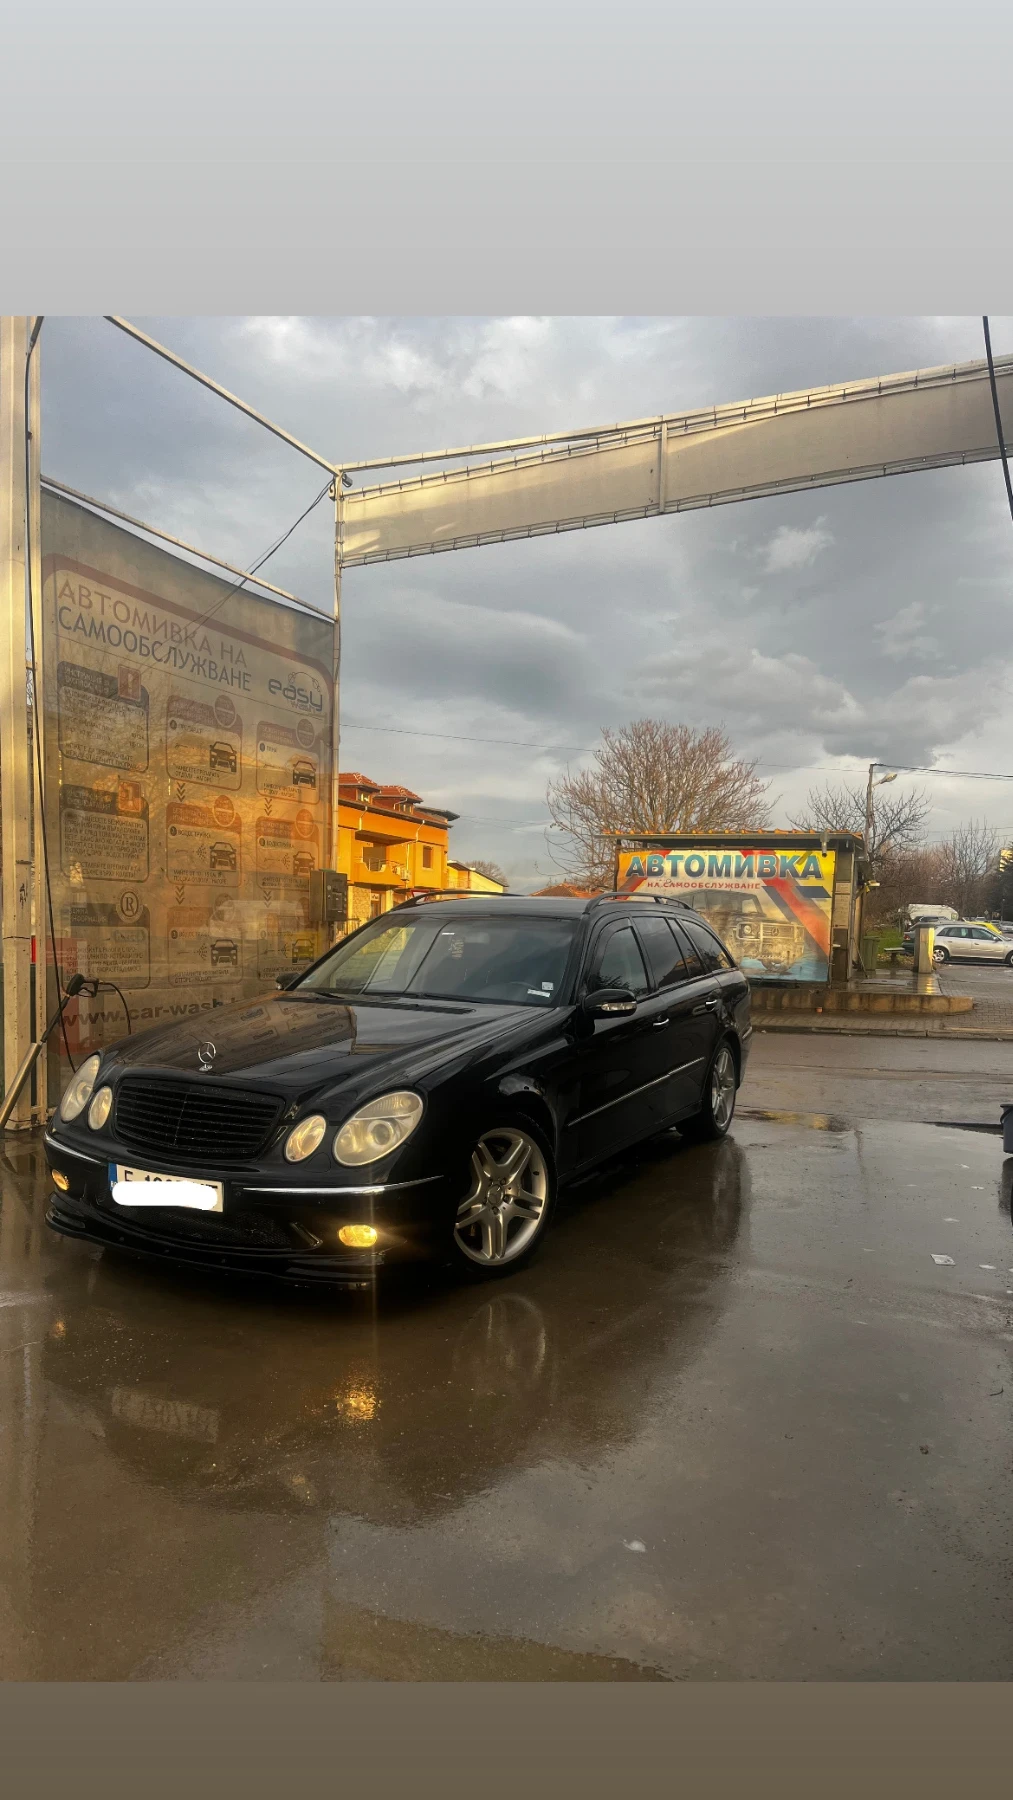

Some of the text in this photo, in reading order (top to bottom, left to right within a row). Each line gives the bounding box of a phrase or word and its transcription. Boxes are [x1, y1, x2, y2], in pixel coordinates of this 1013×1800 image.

[58, 579, 247, 668] АВТОМИВКА НА
[58, 606, 252, 692] САМООБСЛУЖВАНЕ
[268, 678, 323, 712] easy
[625, 853, 824, 880] АВТОМИВКА
[662, 881, 761, 890] САМООБСЛУЖВАНЕ
[59, 997, 236, 1028] www.car-wash
